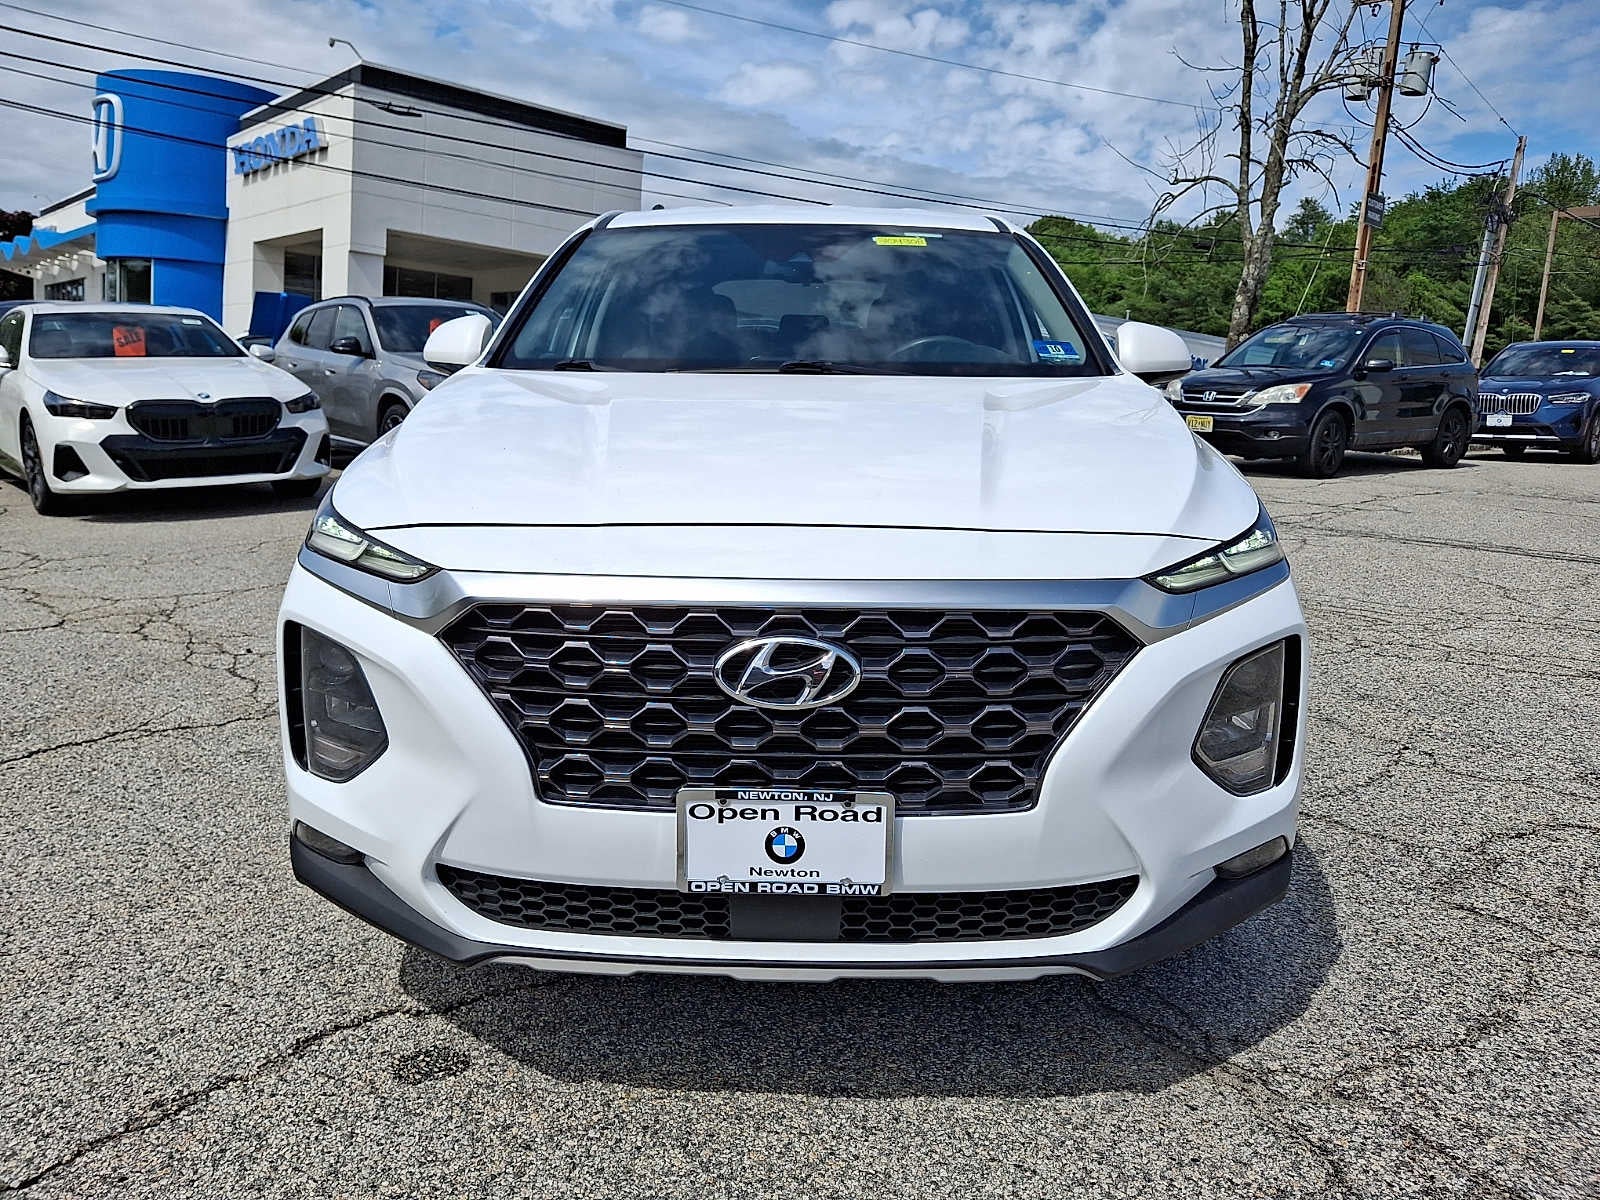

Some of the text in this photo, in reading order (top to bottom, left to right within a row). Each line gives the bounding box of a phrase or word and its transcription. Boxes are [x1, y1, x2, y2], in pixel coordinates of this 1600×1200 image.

[234, 116, 321, 175] HONDA
[116, 330, 143, 347] SALE
[737, 791, 834, 802] NEWTON, NJ
[688, 803, 883, 824] Open Road
[770, 827, 802, 839] BMW
[749, 866, 820, 878] Newton
[690, 881, 879, 895] OPEN ROAD BMW
